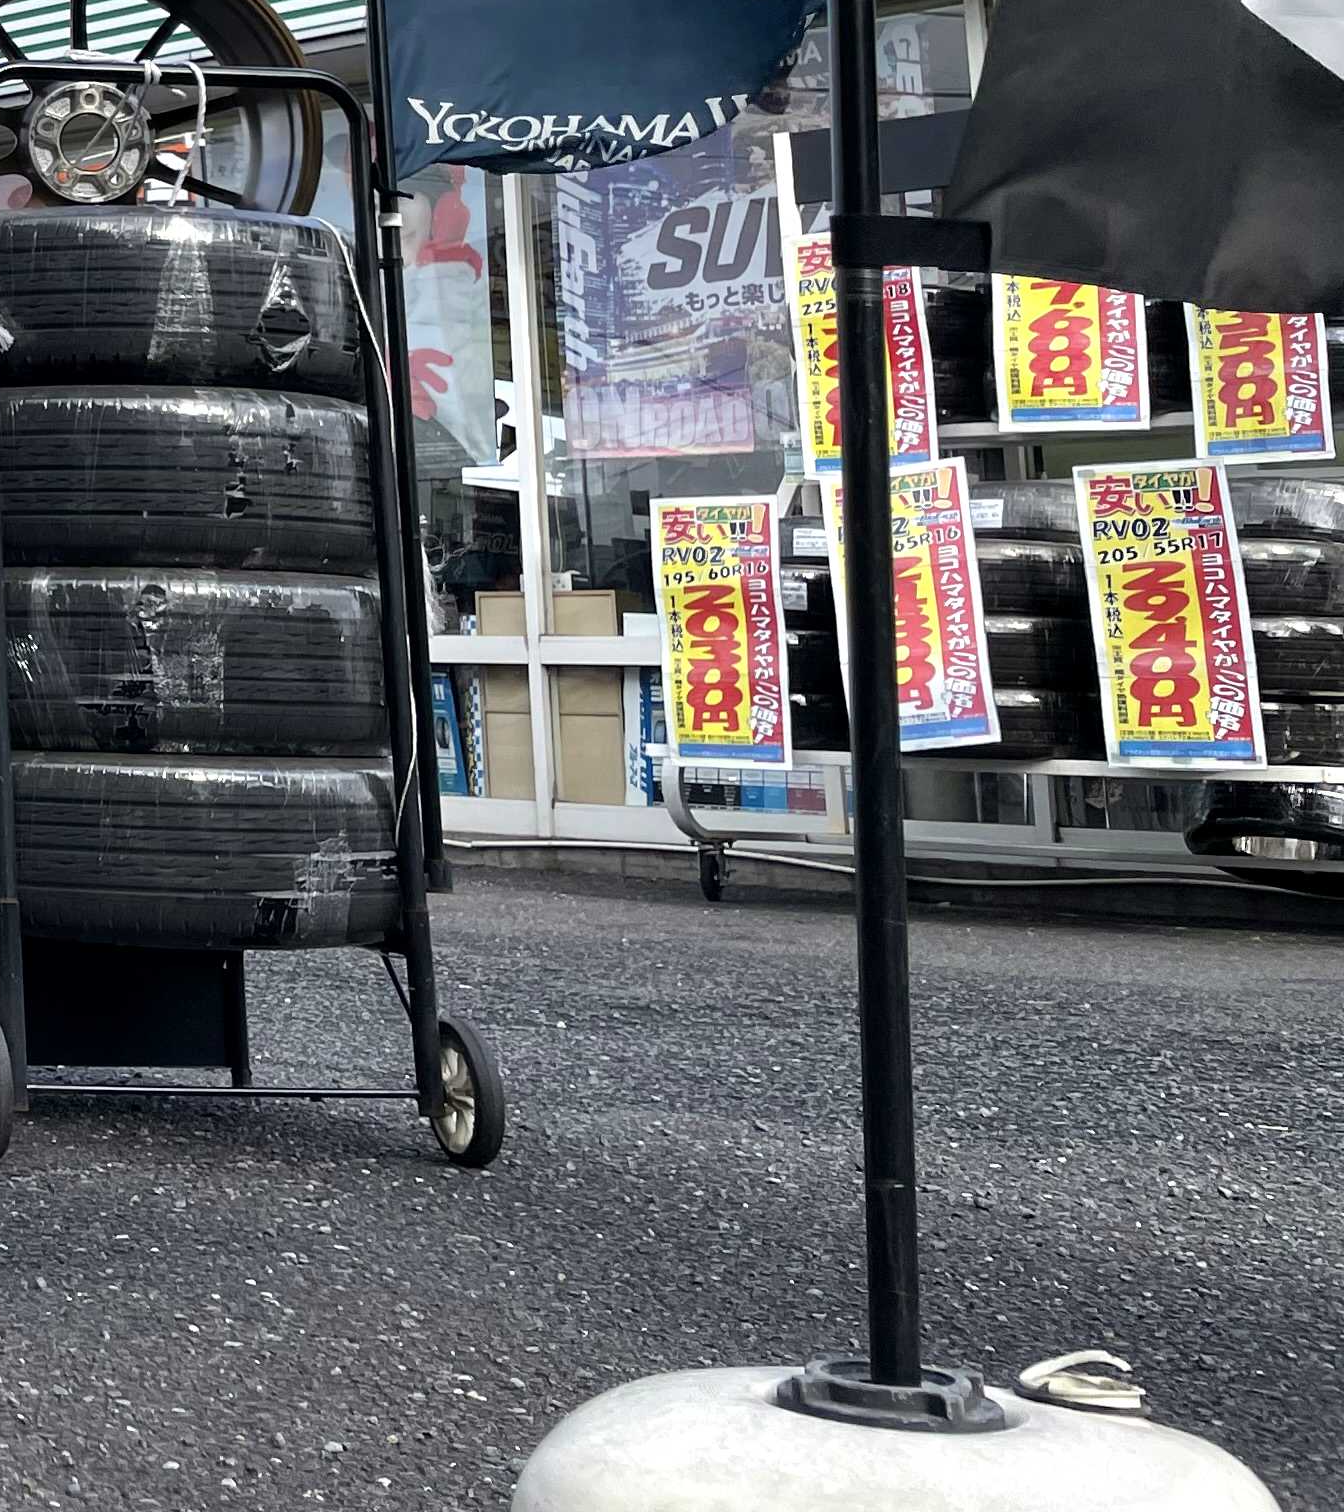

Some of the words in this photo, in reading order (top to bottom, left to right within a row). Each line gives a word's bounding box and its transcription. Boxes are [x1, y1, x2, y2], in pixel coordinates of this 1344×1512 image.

[408, 96, 700, 150] YOKOHAMA
[1092, 517, 1171, 540] RV02
[661, 546, 726, 566] RV02
[1097, 532, 1224, 565] 205/55R17
[663, 561, 769, 587] 195/60R16
